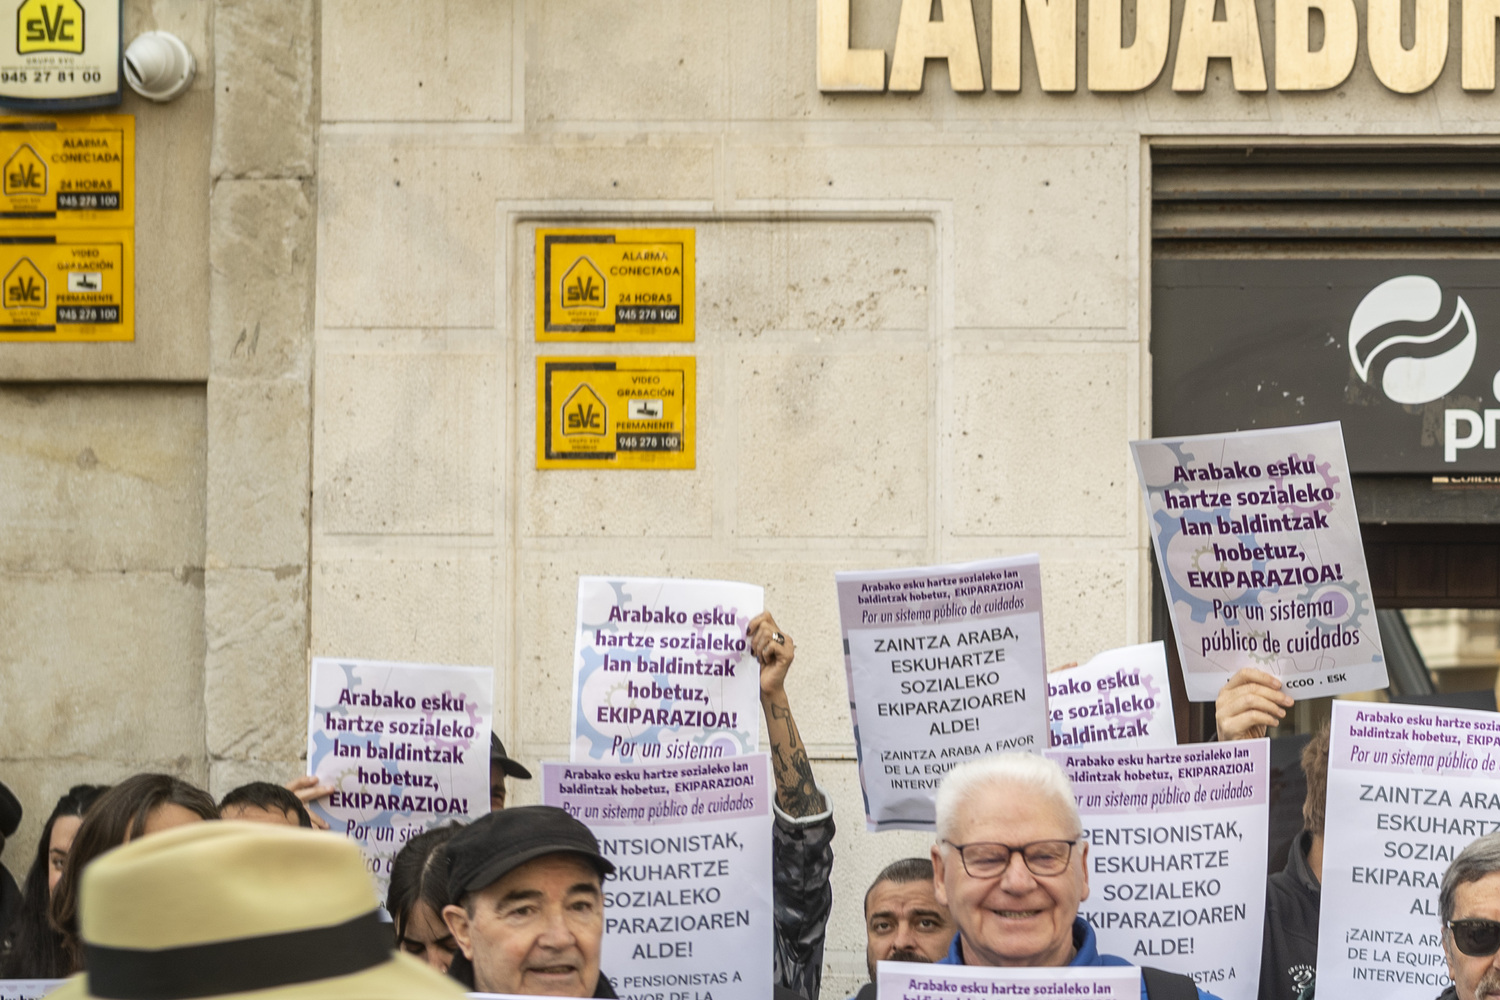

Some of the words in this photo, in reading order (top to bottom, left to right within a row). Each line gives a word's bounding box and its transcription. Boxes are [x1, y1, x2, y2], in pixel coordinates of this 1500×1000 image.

[26, 5, 75, 42] SVC
[1, 71, 27, 83] 945
[34, 71, 51, 83] 27
[58, 71, 74, 83] 81
[82, 71, 101, 83] 00
[622, 251, 668, 262] ALARMA
[610, 266, 680, 276] CONECTADA
[567, 276, 600, 301] SVC
[619, 293, 631, 303] 24
[634, 293, 672, 303] HORAS
[618, 309, 636, 320] 945
[639, 309, 657, 320] 278
[660, 309, 677, 320] 100
[617, 387, 675, 397] GRABACIÓN
[631, 376, 660, 385] VIDEO
[567, 403, 600, 428] SVC
[616, 421, 674, 430] PERMANENTE
[619, 436, 637, 448] 945
[639, 436, 658, 448] 278
[660, 436, 678, 448] 100
[1173, 461, 1262, 483] Arabako
[1266, 457, 1316, 477] esku
[1163, 488, 1232, 509] hartze
[1236, 483, 1334, 506] sozialeko
[1179, 516, 1213, 536] lan
[1216, 509, 1329, 535] baldintzak
[1212, 542, 1306, 562] hobetuz,
[1187, 563, 1343, 589] EKIPARAZIOA!
[1212, 598, 1239, 620] Por
[1245, 605, 1264, 621] un
[1269, 599, 1333, 621] sistema
[874, 634, 951, 653] ZAINTZA
[956, 626, 1019, 647] ARABA,
[1201, 628, 1258, 657] público
[1262, 630, 1281, 654] de
[1286, 623, 1360, 654] cuidados
[891, 648, 1005, 674] ESKUHARTZE
[900, 671, 1000, 695] SOZIALEKO
[1286, 678, 1315, 689] CCOO
[1326, 673, 1347, 683] ESK
[877, 688, 1026, 716] EKIPARAZIOAREN
[908, 978, 958, 993] Arabako
[960, 981, 988, 994] esku
[991, 982, 1031, 995] hartze
[1033, 982, 1090, 995] sozialeko
[1093, 982, 1111, 994] lan
